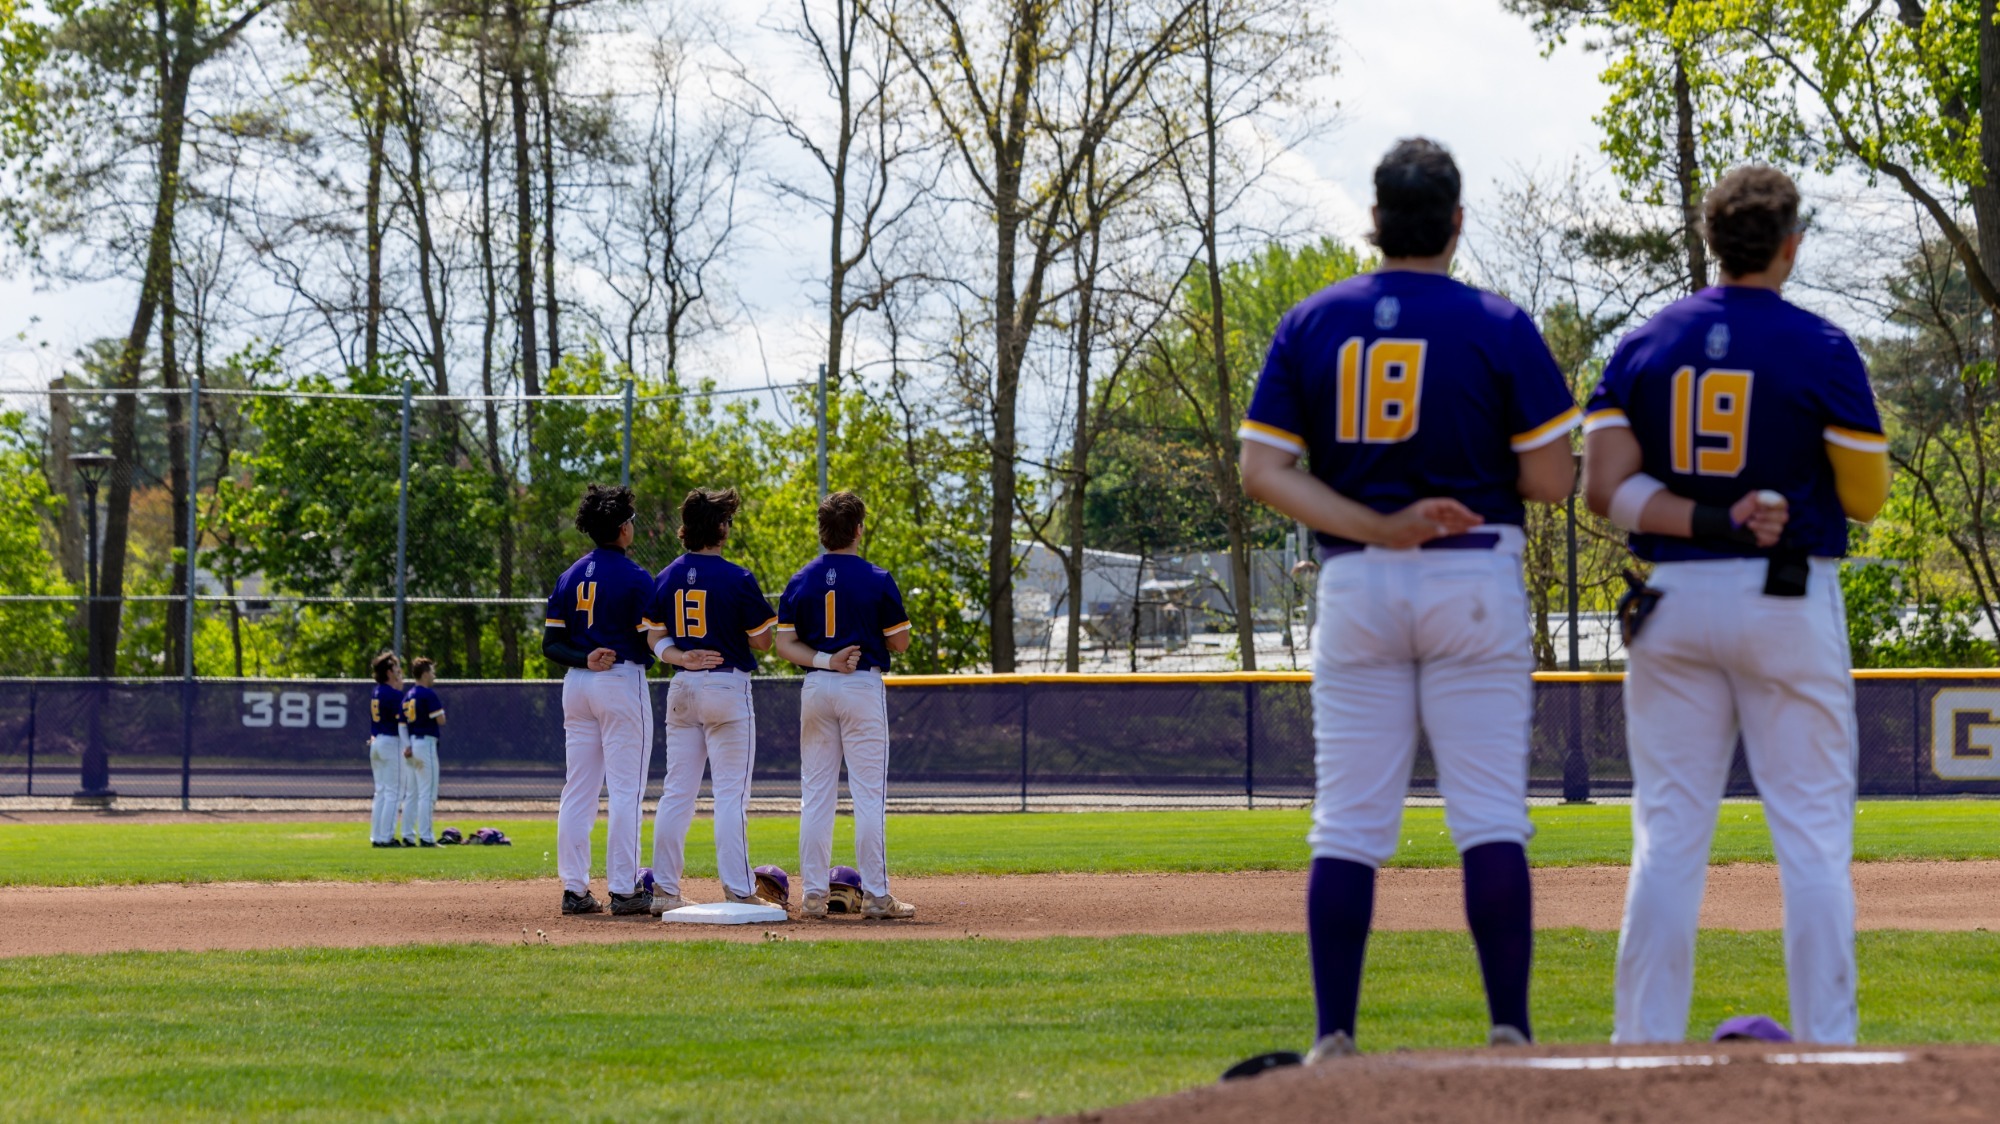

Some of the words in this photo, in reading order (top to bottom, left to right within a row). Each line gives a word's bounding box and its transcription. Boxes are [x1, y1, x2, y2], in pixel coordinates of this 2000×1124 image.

[1336, 336, 1429, 444] 18
[1670, 365, 1755, 477] 19
[575, 581, 597, 629] 4
[674, 588, 707, 639] 13
[824, 589, 836, 638] 1
[242, 691, 348, 728] 386
